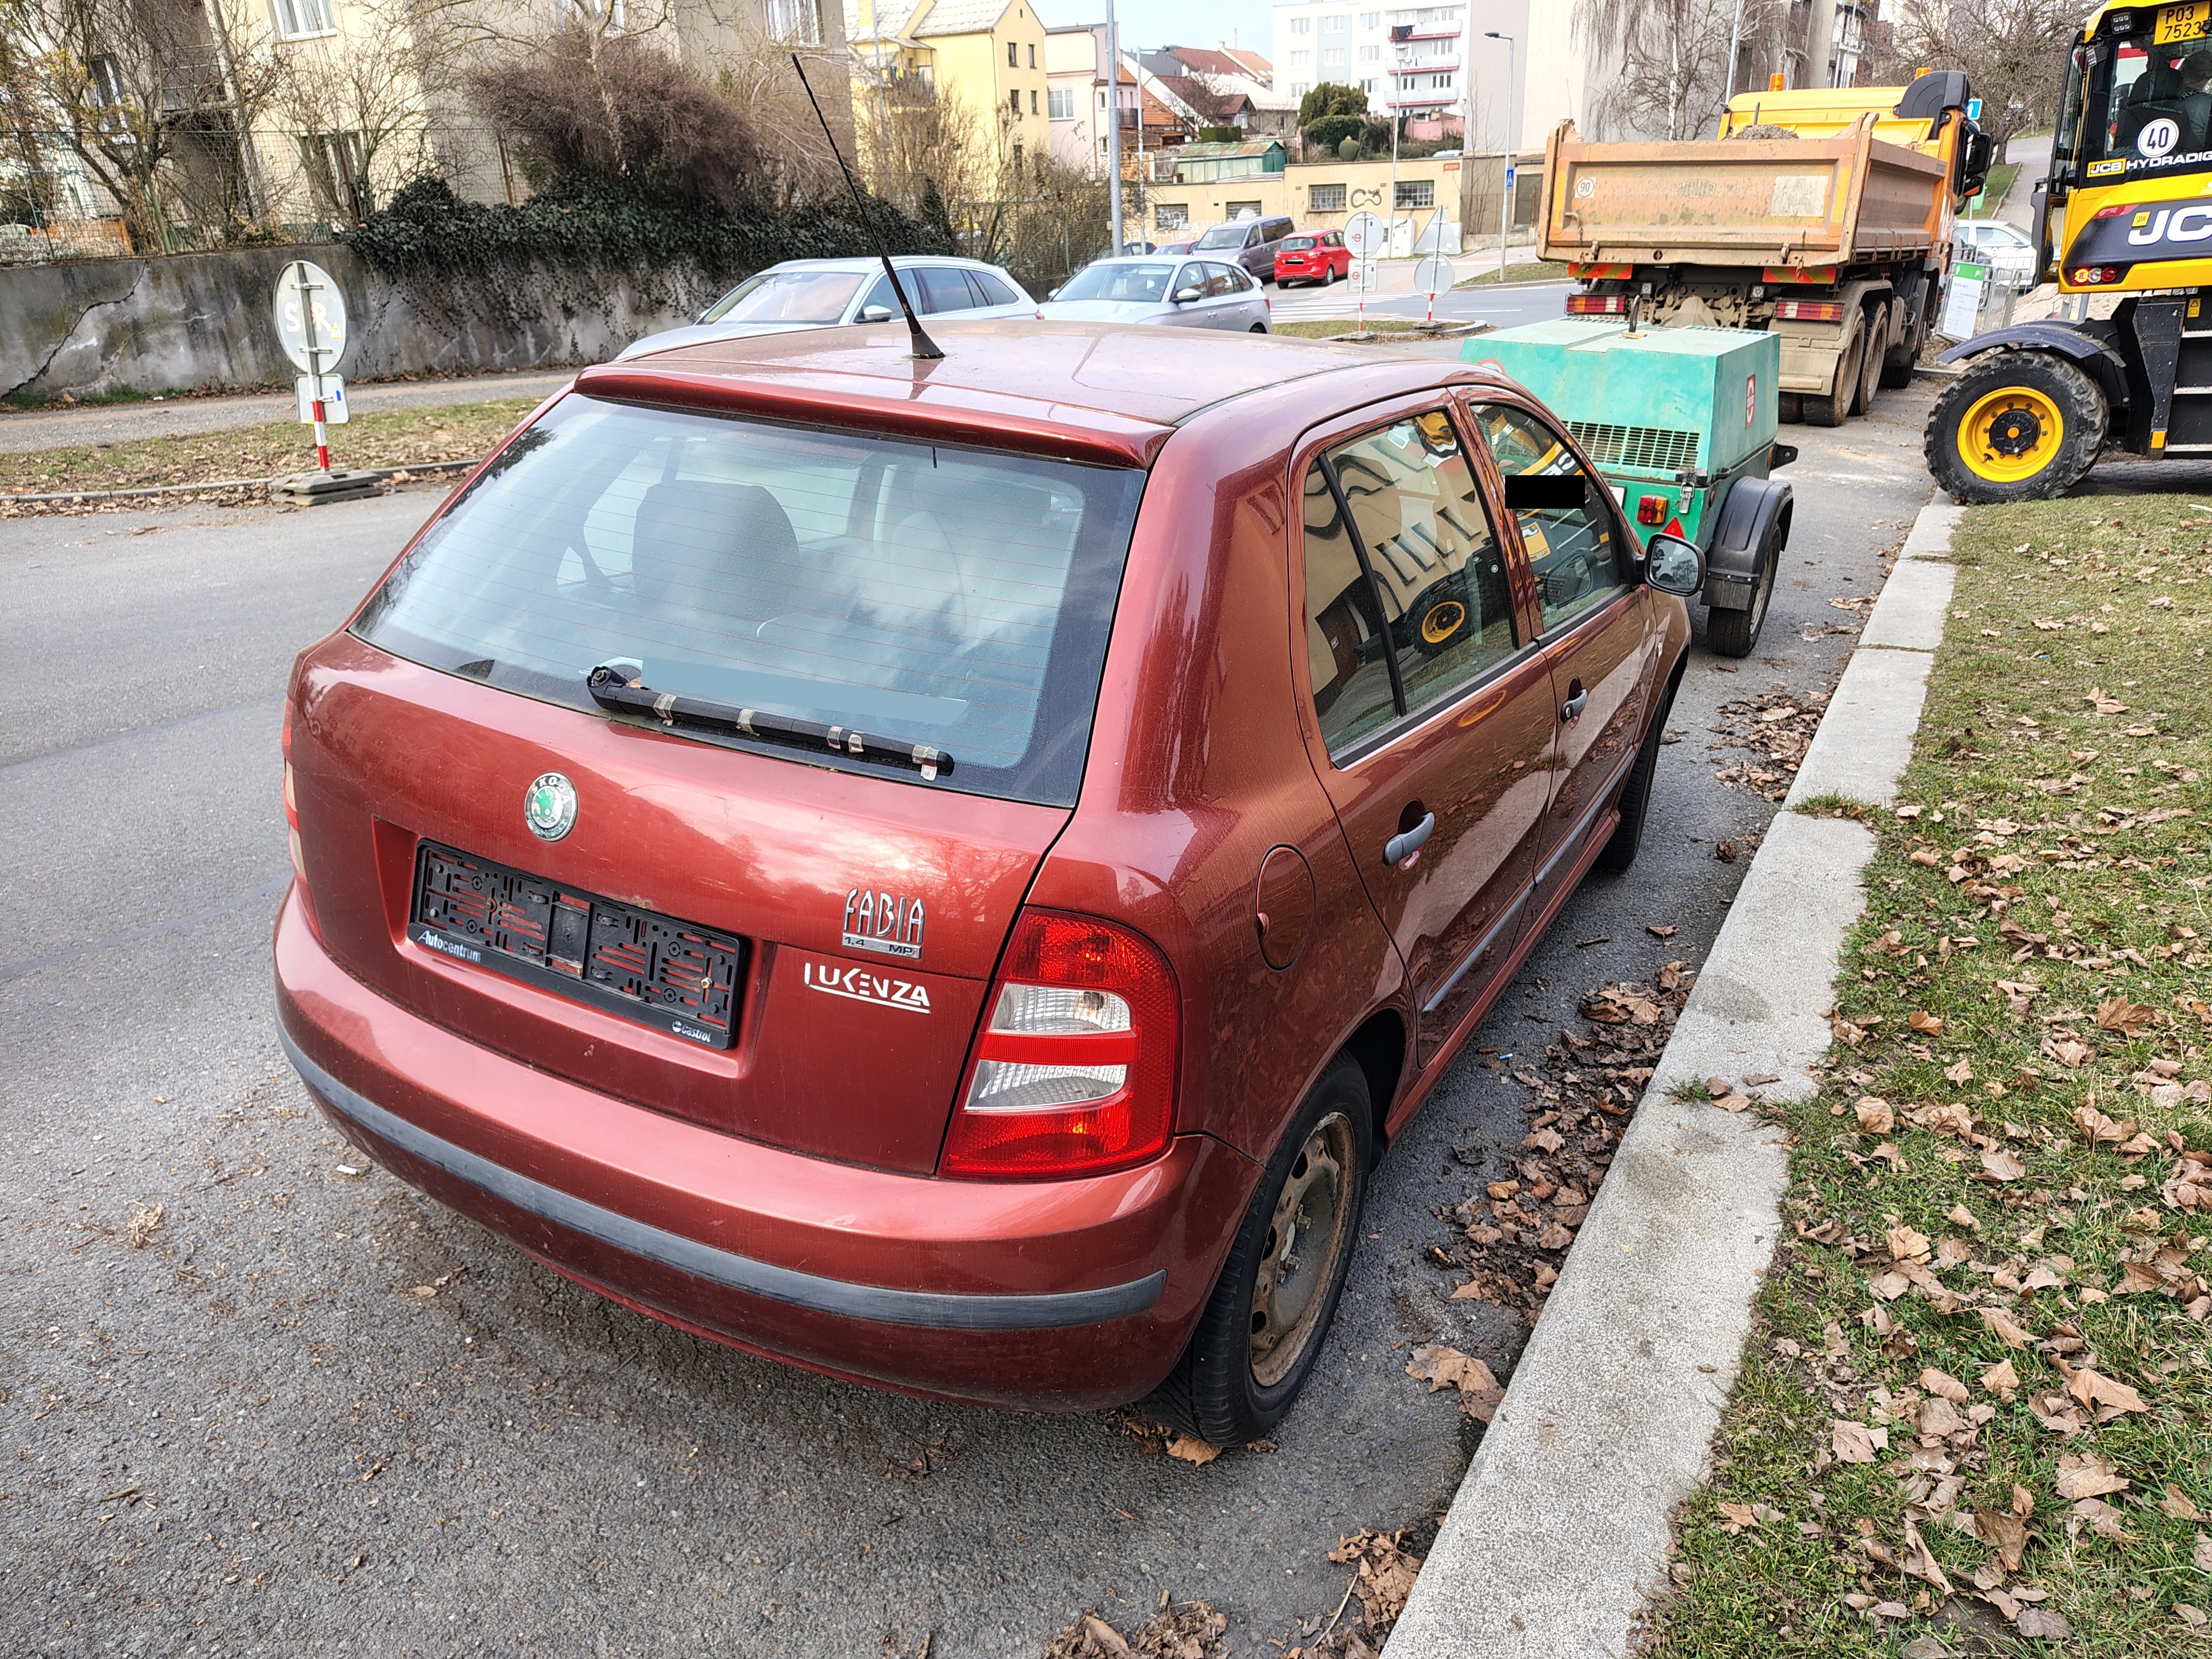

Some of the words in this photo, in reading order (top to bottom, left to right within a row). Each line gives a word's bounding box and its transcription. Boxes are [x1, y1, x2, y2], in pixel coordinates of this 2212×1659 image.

[2163, 21, 2202, 41] 7523
[2147, 126, 2169, 150] 40
[2090, 161, 2122, 174] JCB
[2126, 151, 2212, 170] HYDRADIG
[1580, 181, 1590, 193] 90
[843, 887, 926, 943] FABIA
[417, 930, 481, 963] Autocentrum
[845, 936, 865, 947] 1.4
[682, 1023, 711, 1043] Castrol
